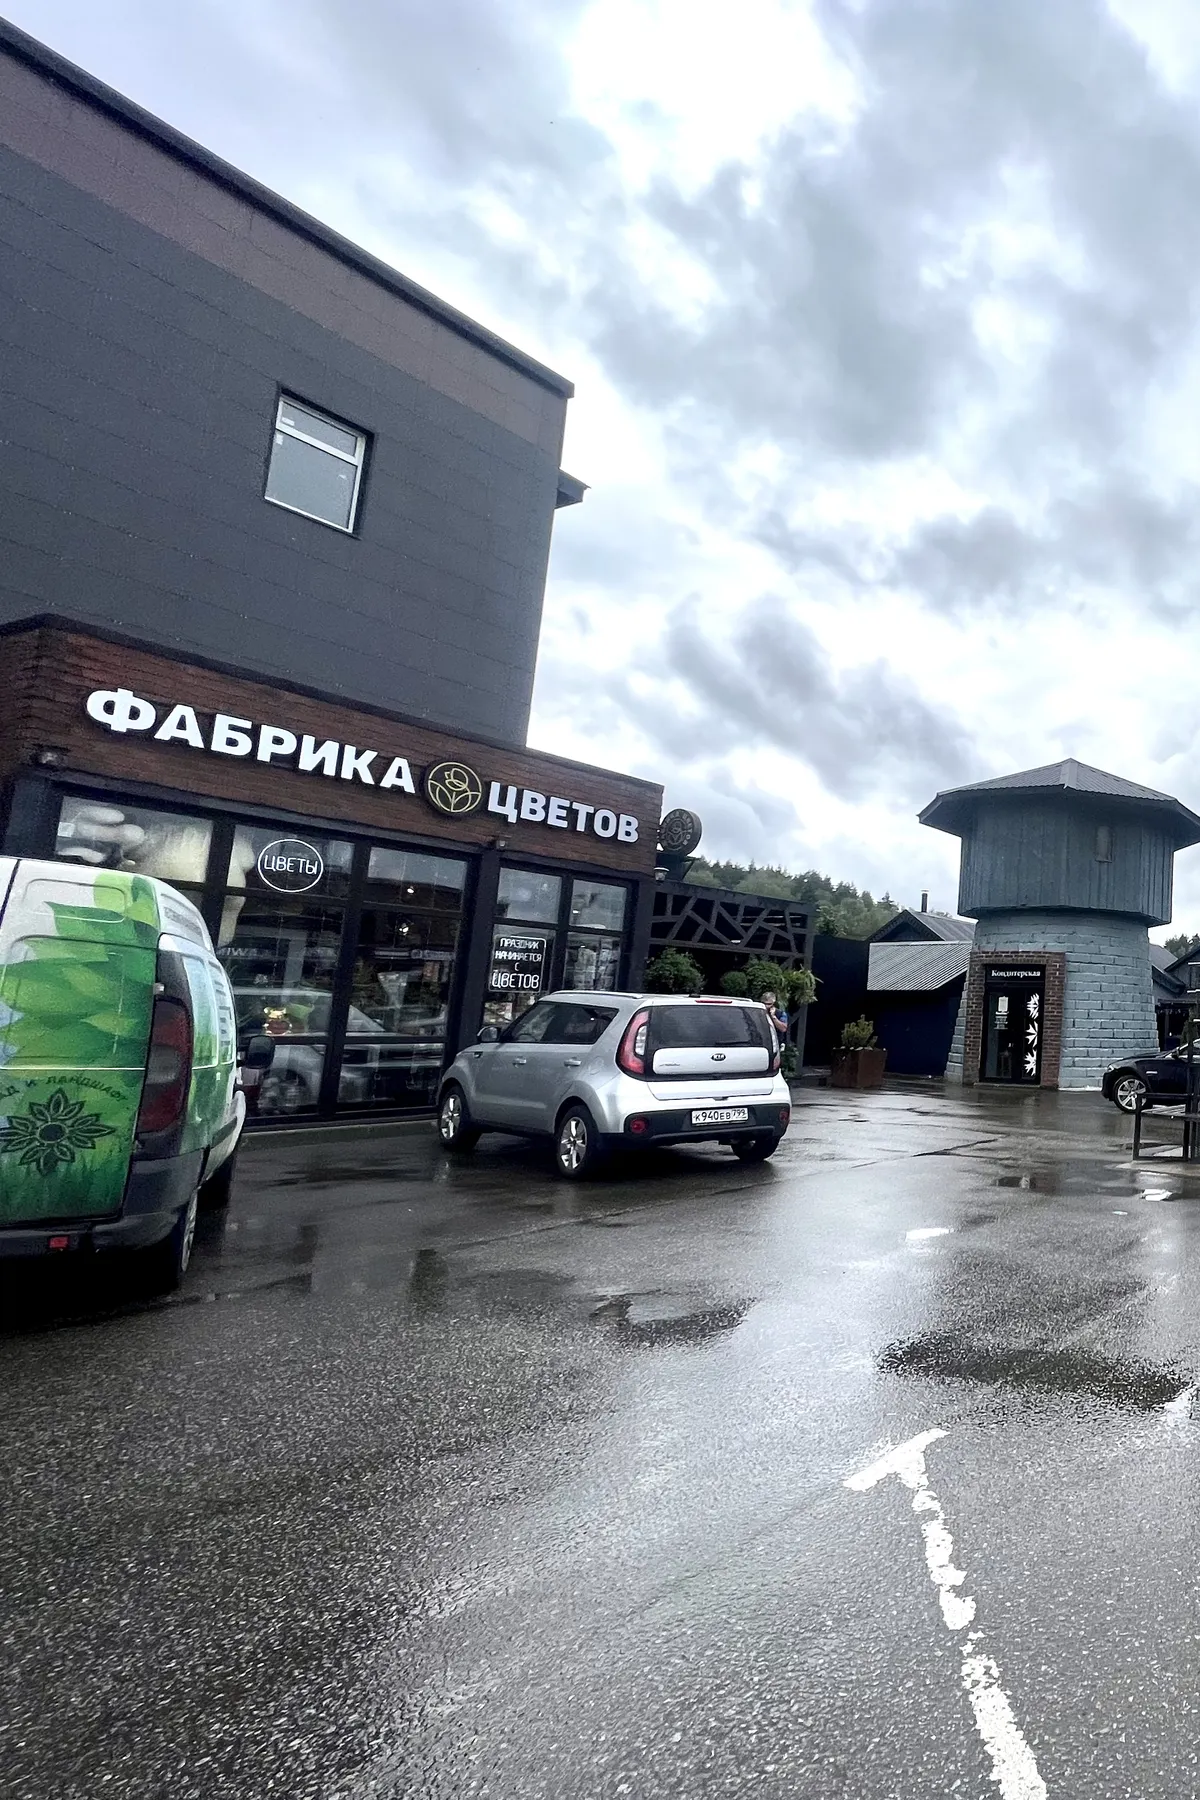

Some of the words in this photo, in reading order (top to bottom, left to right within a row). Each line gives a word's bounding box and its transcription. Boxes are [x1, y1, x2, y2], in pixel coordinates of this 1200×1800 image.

[87, 688, 415, 793] ФАБРИКА
[488, 781, 639, 843] ЦВЕТОВ
[264, 855, 318, 875] ЦВЕТЫ
[500, 938, 540, 949] ПРАЗДНИК
[495, 951, 542, 962] НАЧИНАЕТСЯ
[492, 972, 540, 989] ЦВЕТОВ
[992, 970, 1041, 978] Кондитерская
